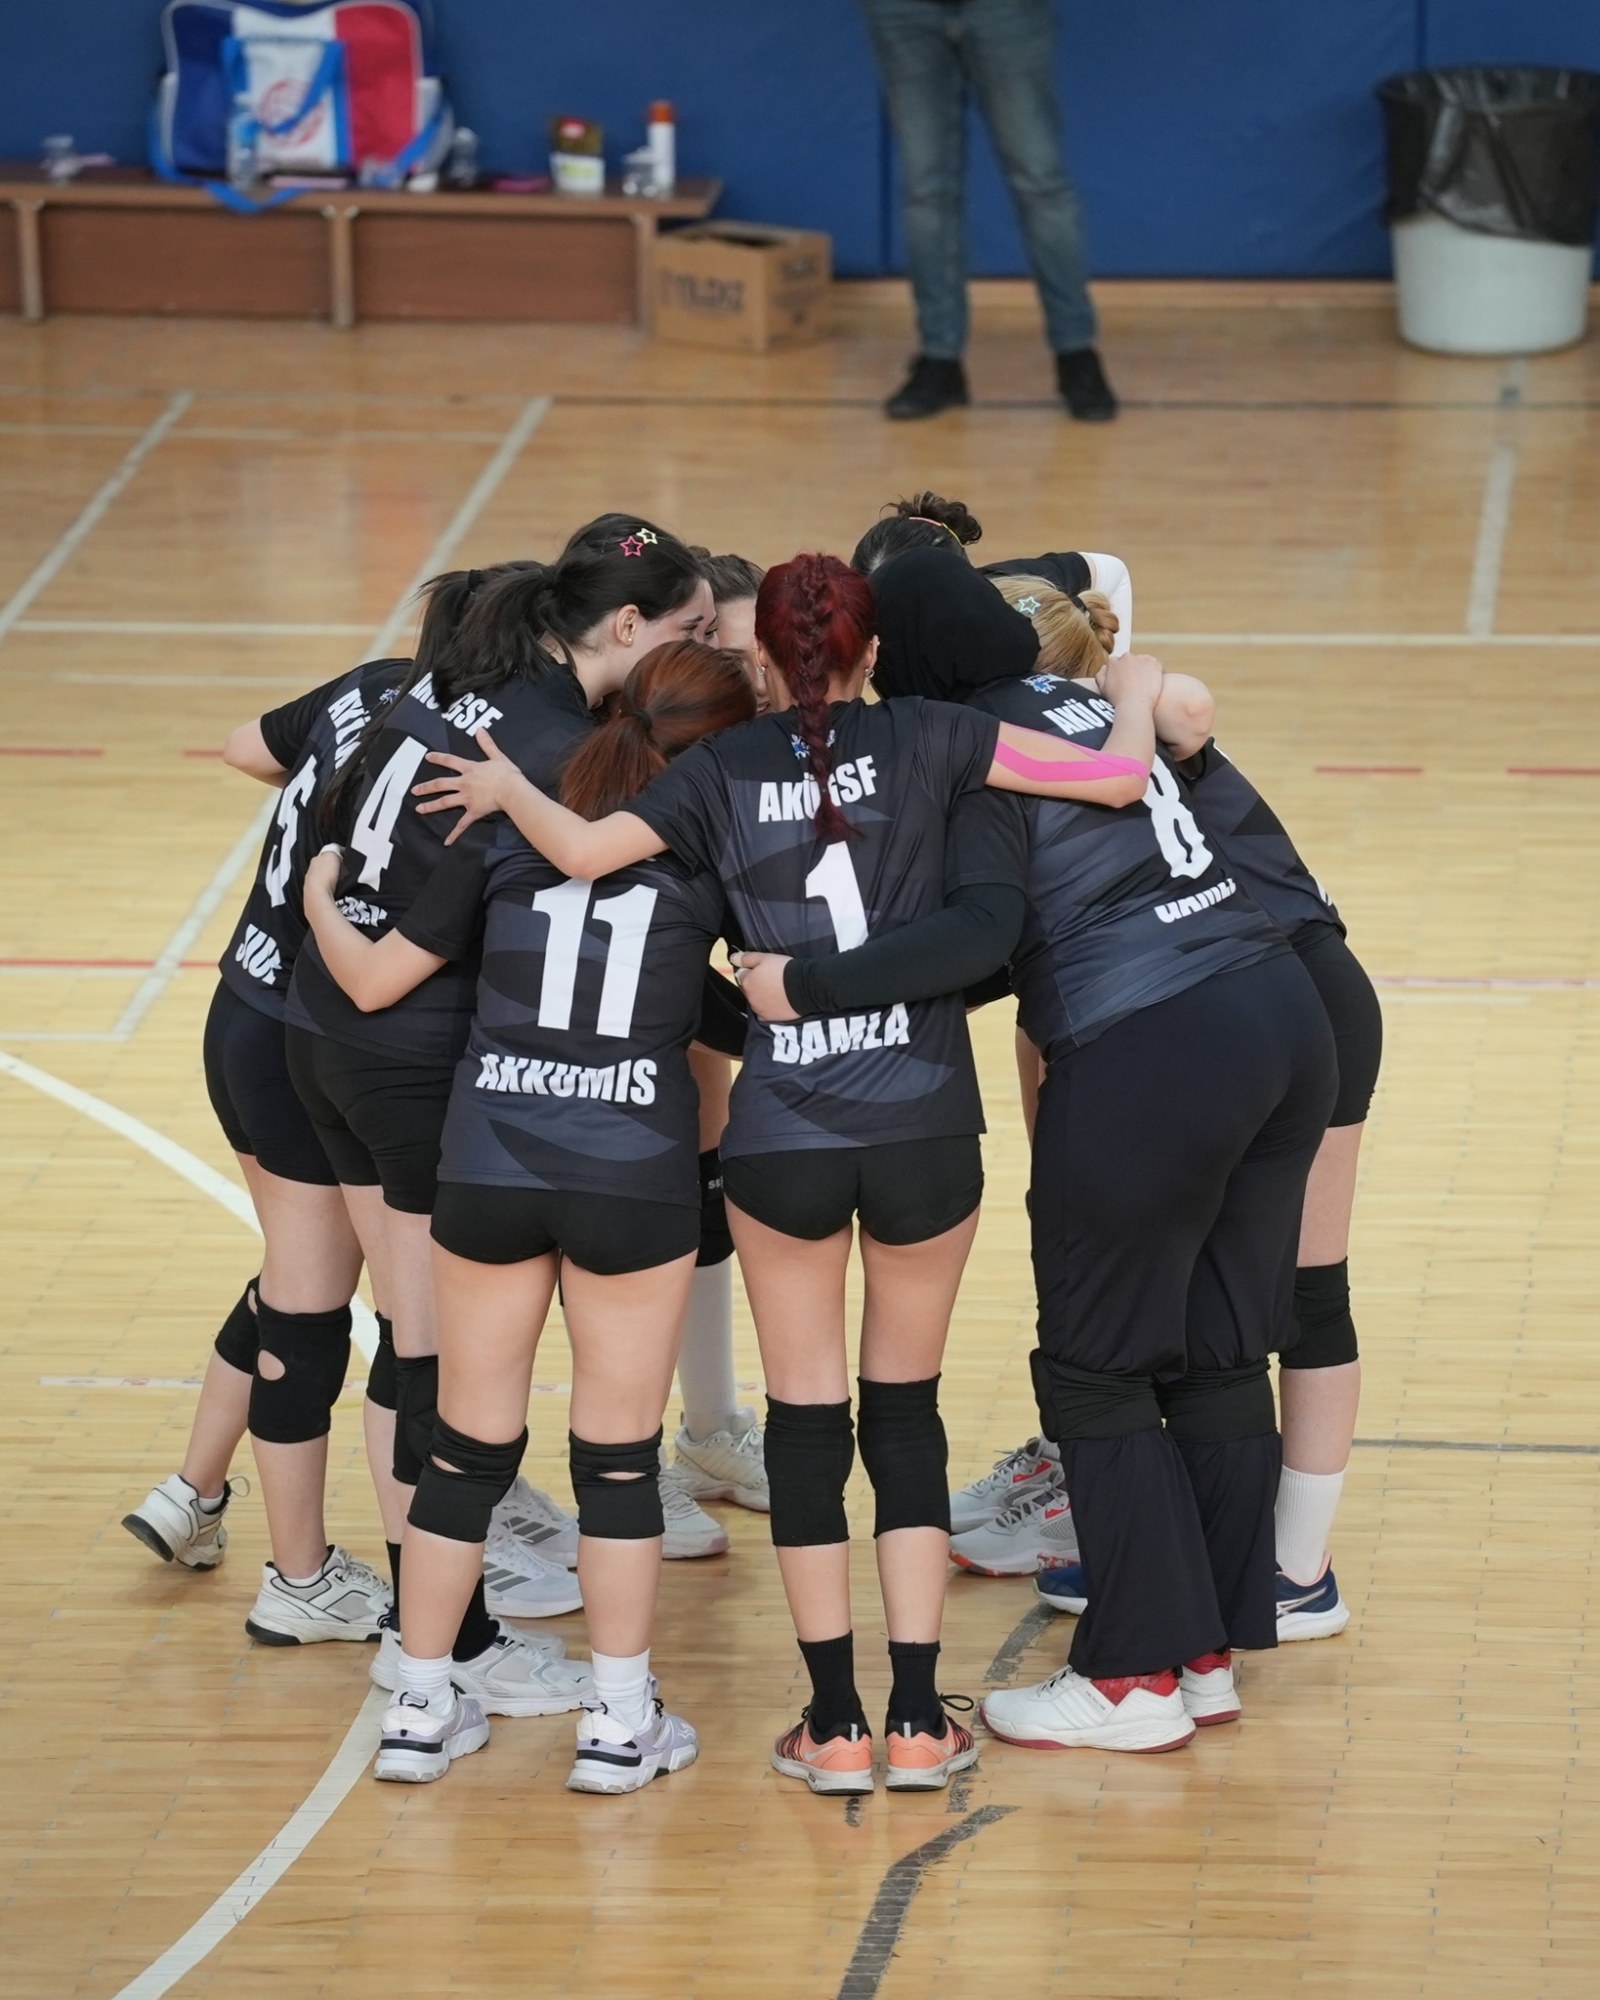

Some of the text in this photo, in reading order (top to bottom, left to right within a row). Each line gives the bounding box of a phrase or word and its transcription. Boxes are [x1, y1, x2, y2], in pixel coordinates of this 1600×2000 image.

[408, 671, 503, 737] AKGSF
[265, 754, 317, 908] 5
[351, 736, 428, 891] 4
[1142, 753, 1213, 879] 8
[532, 877, 658, 1038] 11
[806, 841, 868, 953] 1
[769, 1002, 910, 1066] DAMLA
